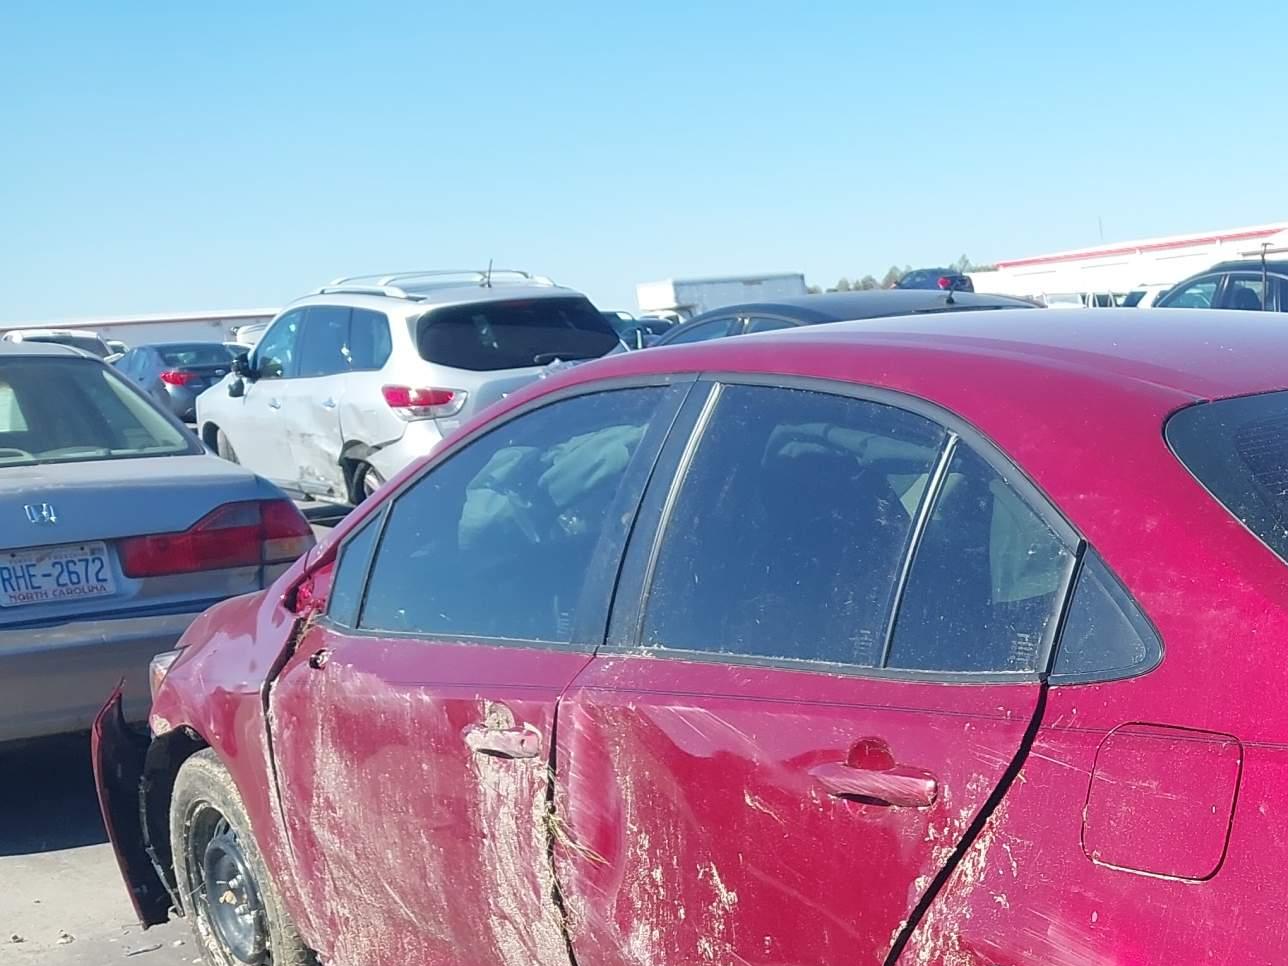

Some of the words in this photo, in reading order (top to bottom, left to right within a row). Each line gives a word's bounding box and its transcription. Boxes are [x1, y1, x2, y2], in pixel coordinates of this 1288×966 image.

[0, 556, 108, 593] RHE-2672
[8, 590, 49, 603] NORTH
[51, 583, 107, 598] CAROLINA
